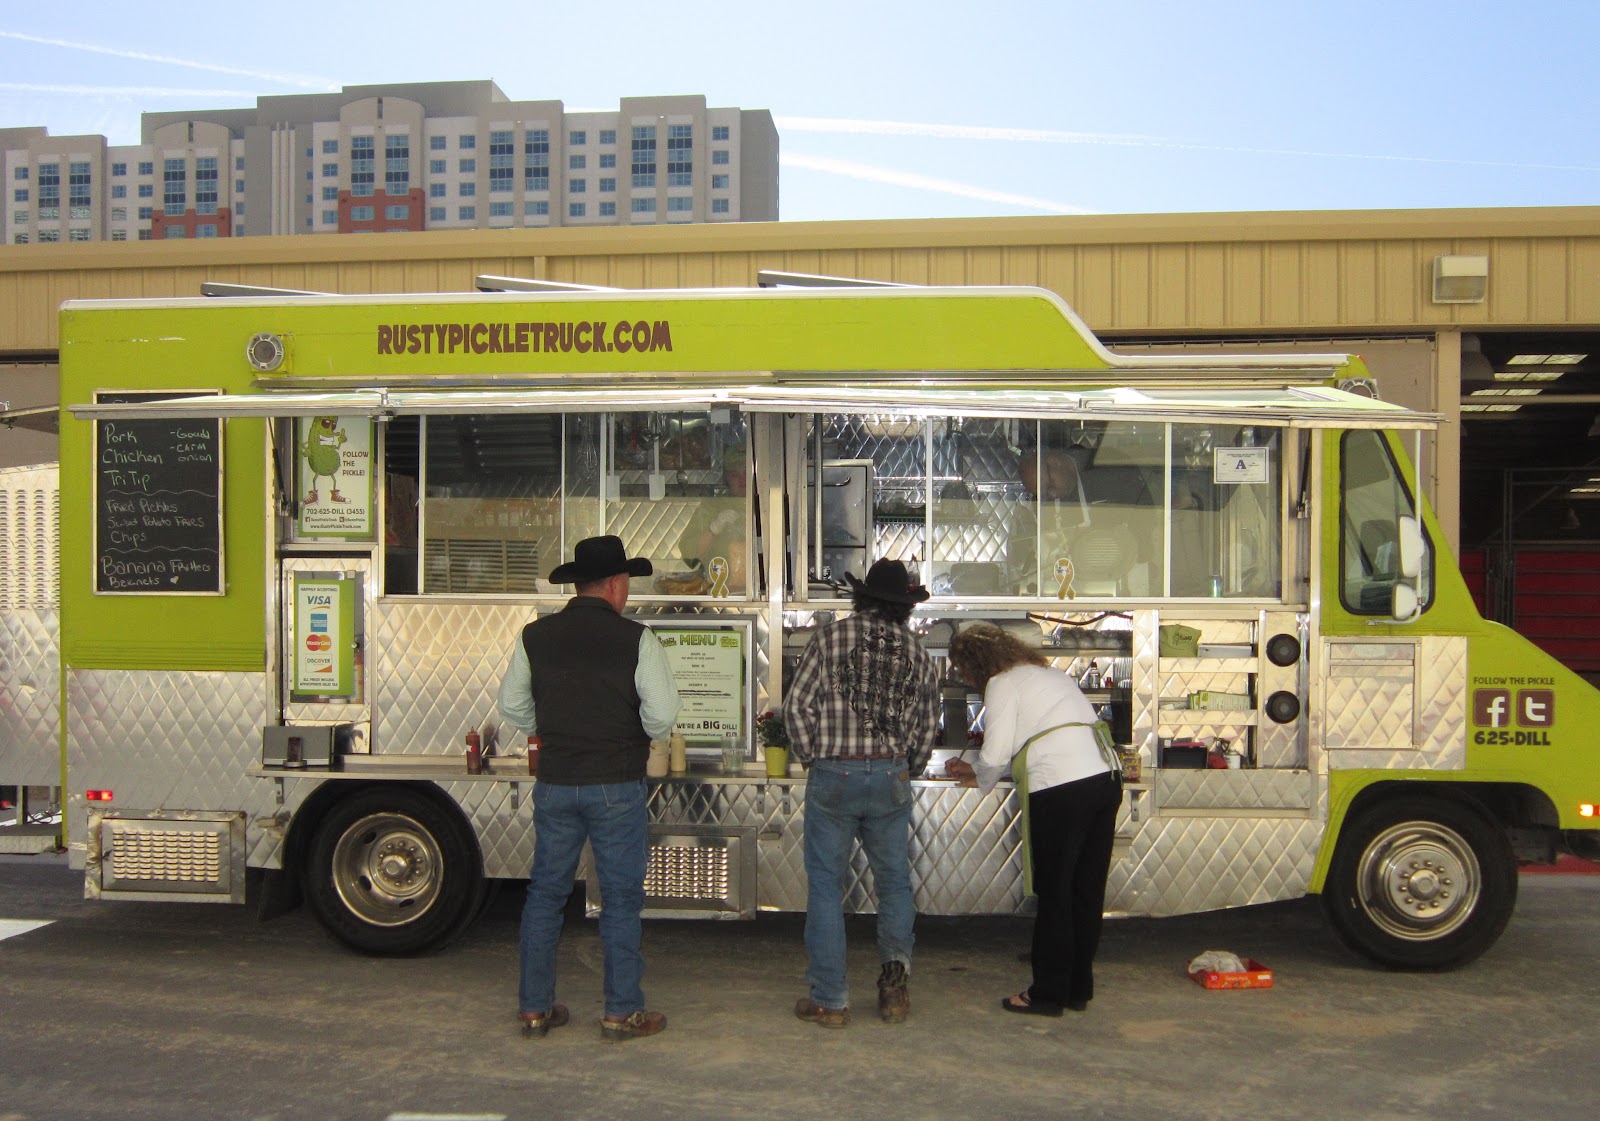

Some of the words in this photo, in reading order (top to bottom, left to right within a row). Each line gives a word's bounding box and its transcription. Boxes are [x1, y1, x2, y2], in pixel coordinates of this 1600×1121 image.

[378, 321, 673, 354] RUSTYPICKLETRUCK.COM
[105, 423, 137, 444] Pork
[103, 449, 163, 464] Chicken
[1235, 459, 1247, 470] A
[104, 470, 126, 486] Tri
[128, 471, 150, 491] Tip
[110, 530, 147, 547] Chips
[101, 555, 166, 576] Banana
[307, 595, 331, 605] VISA
[680, 634, 717, 646] MENU
[1473, 677, 1508, 685] FOLLOW
[1509, 677, 1526, 685] THE
[1527, 677, 1555, 685] PICKLE
[702, 720, 720, 730] BIG
[1474, 731, 1551, 746] 625-DILL
